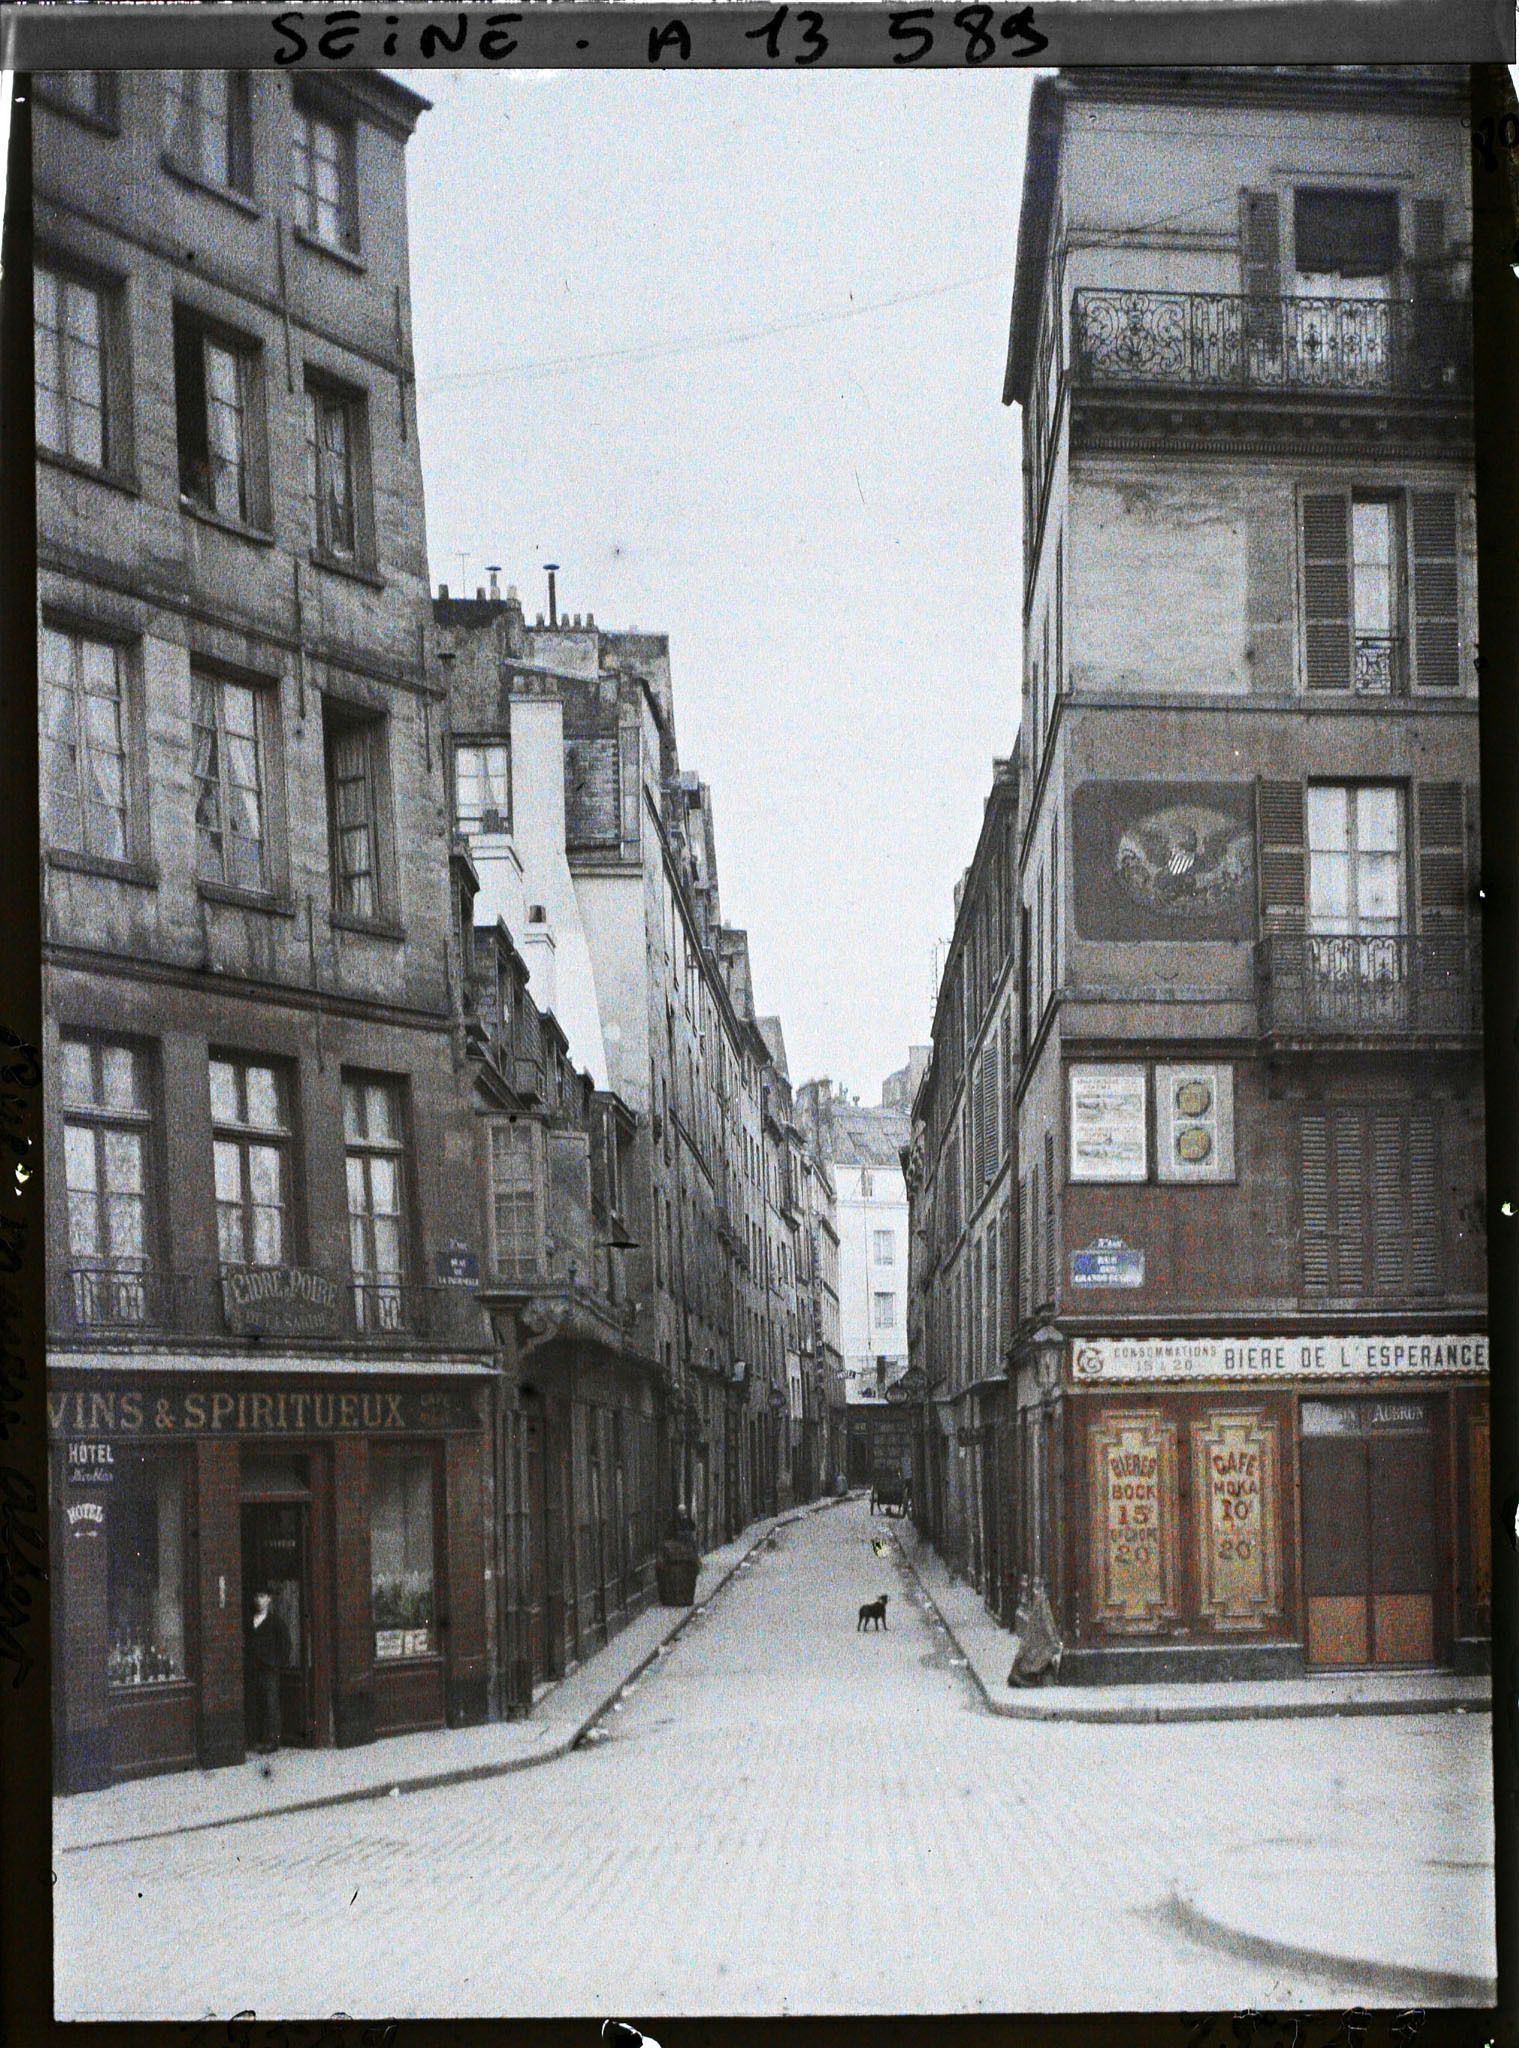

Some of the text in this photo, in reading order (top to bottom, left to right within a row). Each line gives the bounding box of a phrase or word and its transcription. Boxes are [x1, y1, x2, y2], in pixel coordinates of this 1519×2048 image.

[648, 20, 691, 63] A
[745, 5, 829, 64] 13
[1113, 1346, 1217, 1358] CONSOMMATIONS
[1224, 1347, 1285, 1370] BIERE
[1301, 1346, 1325, 1369] DE
[1173, 1359, 1193, 1371] 20
[46, 1392, 143, 1429] VINS
[155, 1398, 176, 1429] &
[185, 1392, 405, 1430] SPIRITUEUX
[1112, 1484, 1157, 1501] BOCK
[1213, 1480, 1259, 1498] MOKA
